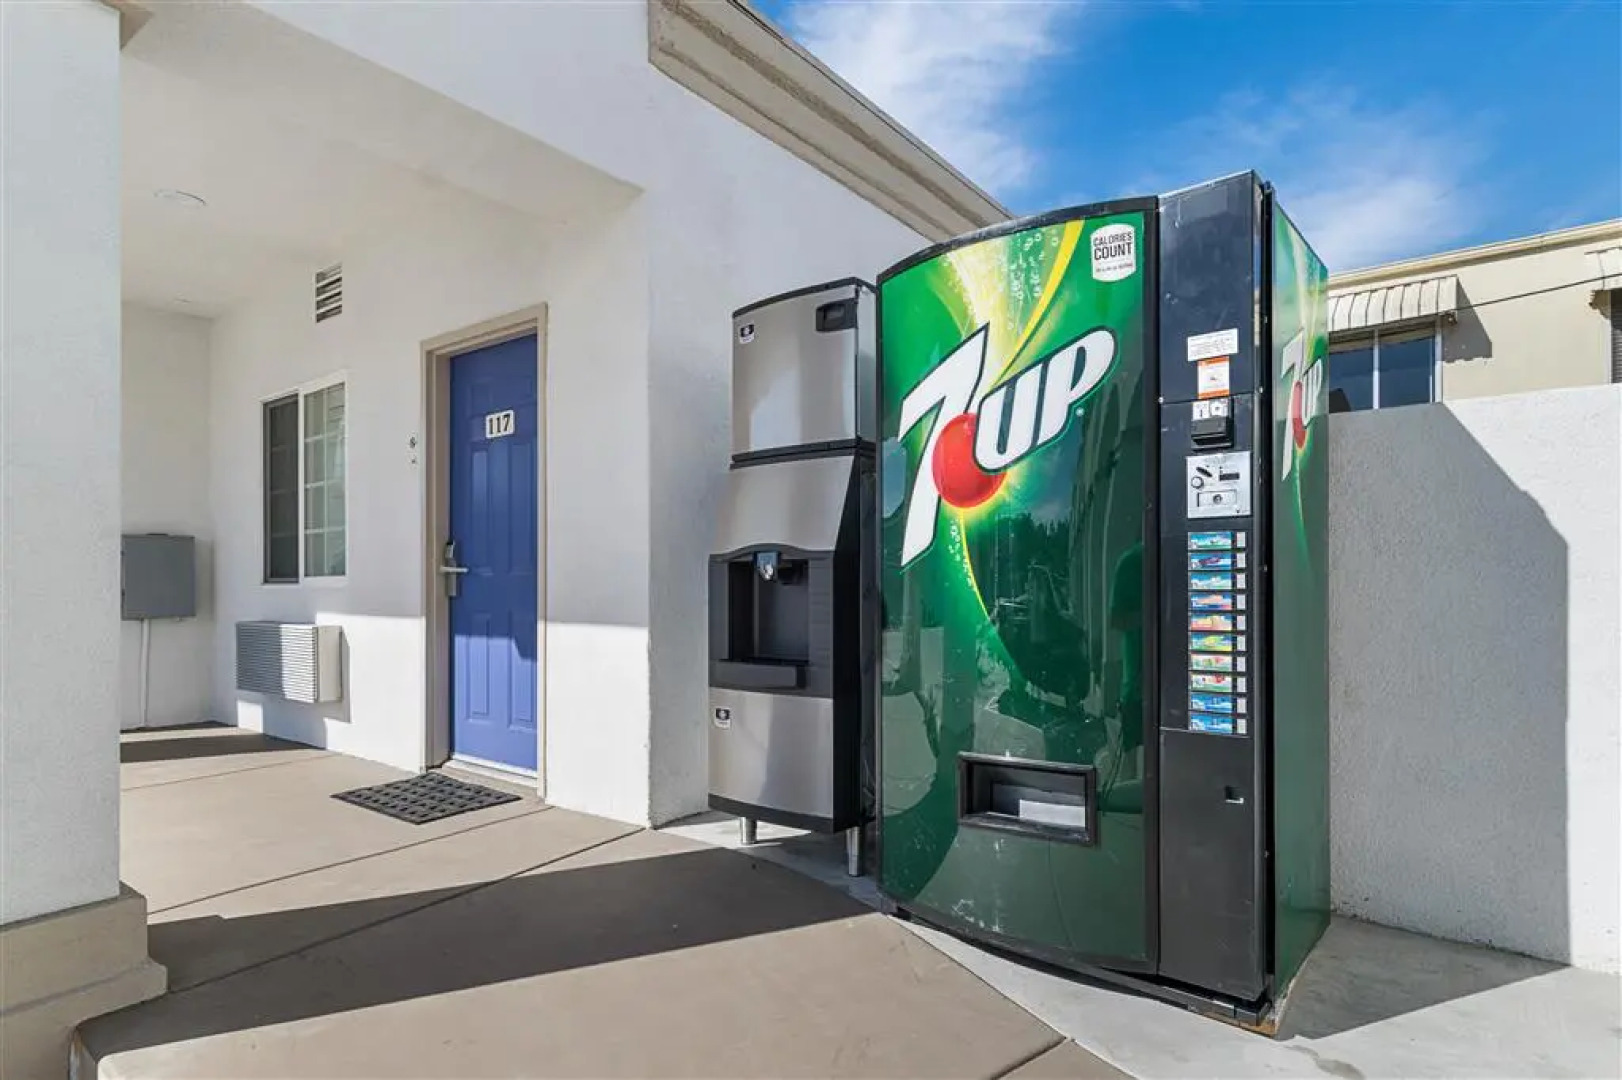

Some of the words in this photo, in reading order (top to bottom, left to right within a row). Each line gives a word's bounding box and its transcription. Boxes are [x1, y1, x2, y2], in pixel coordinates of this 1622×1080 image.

[1093, 231, 1133, 246] CALORIES
[1094, 242, 1132, 261] COUNT
[488, 413, 512, 435] 117
